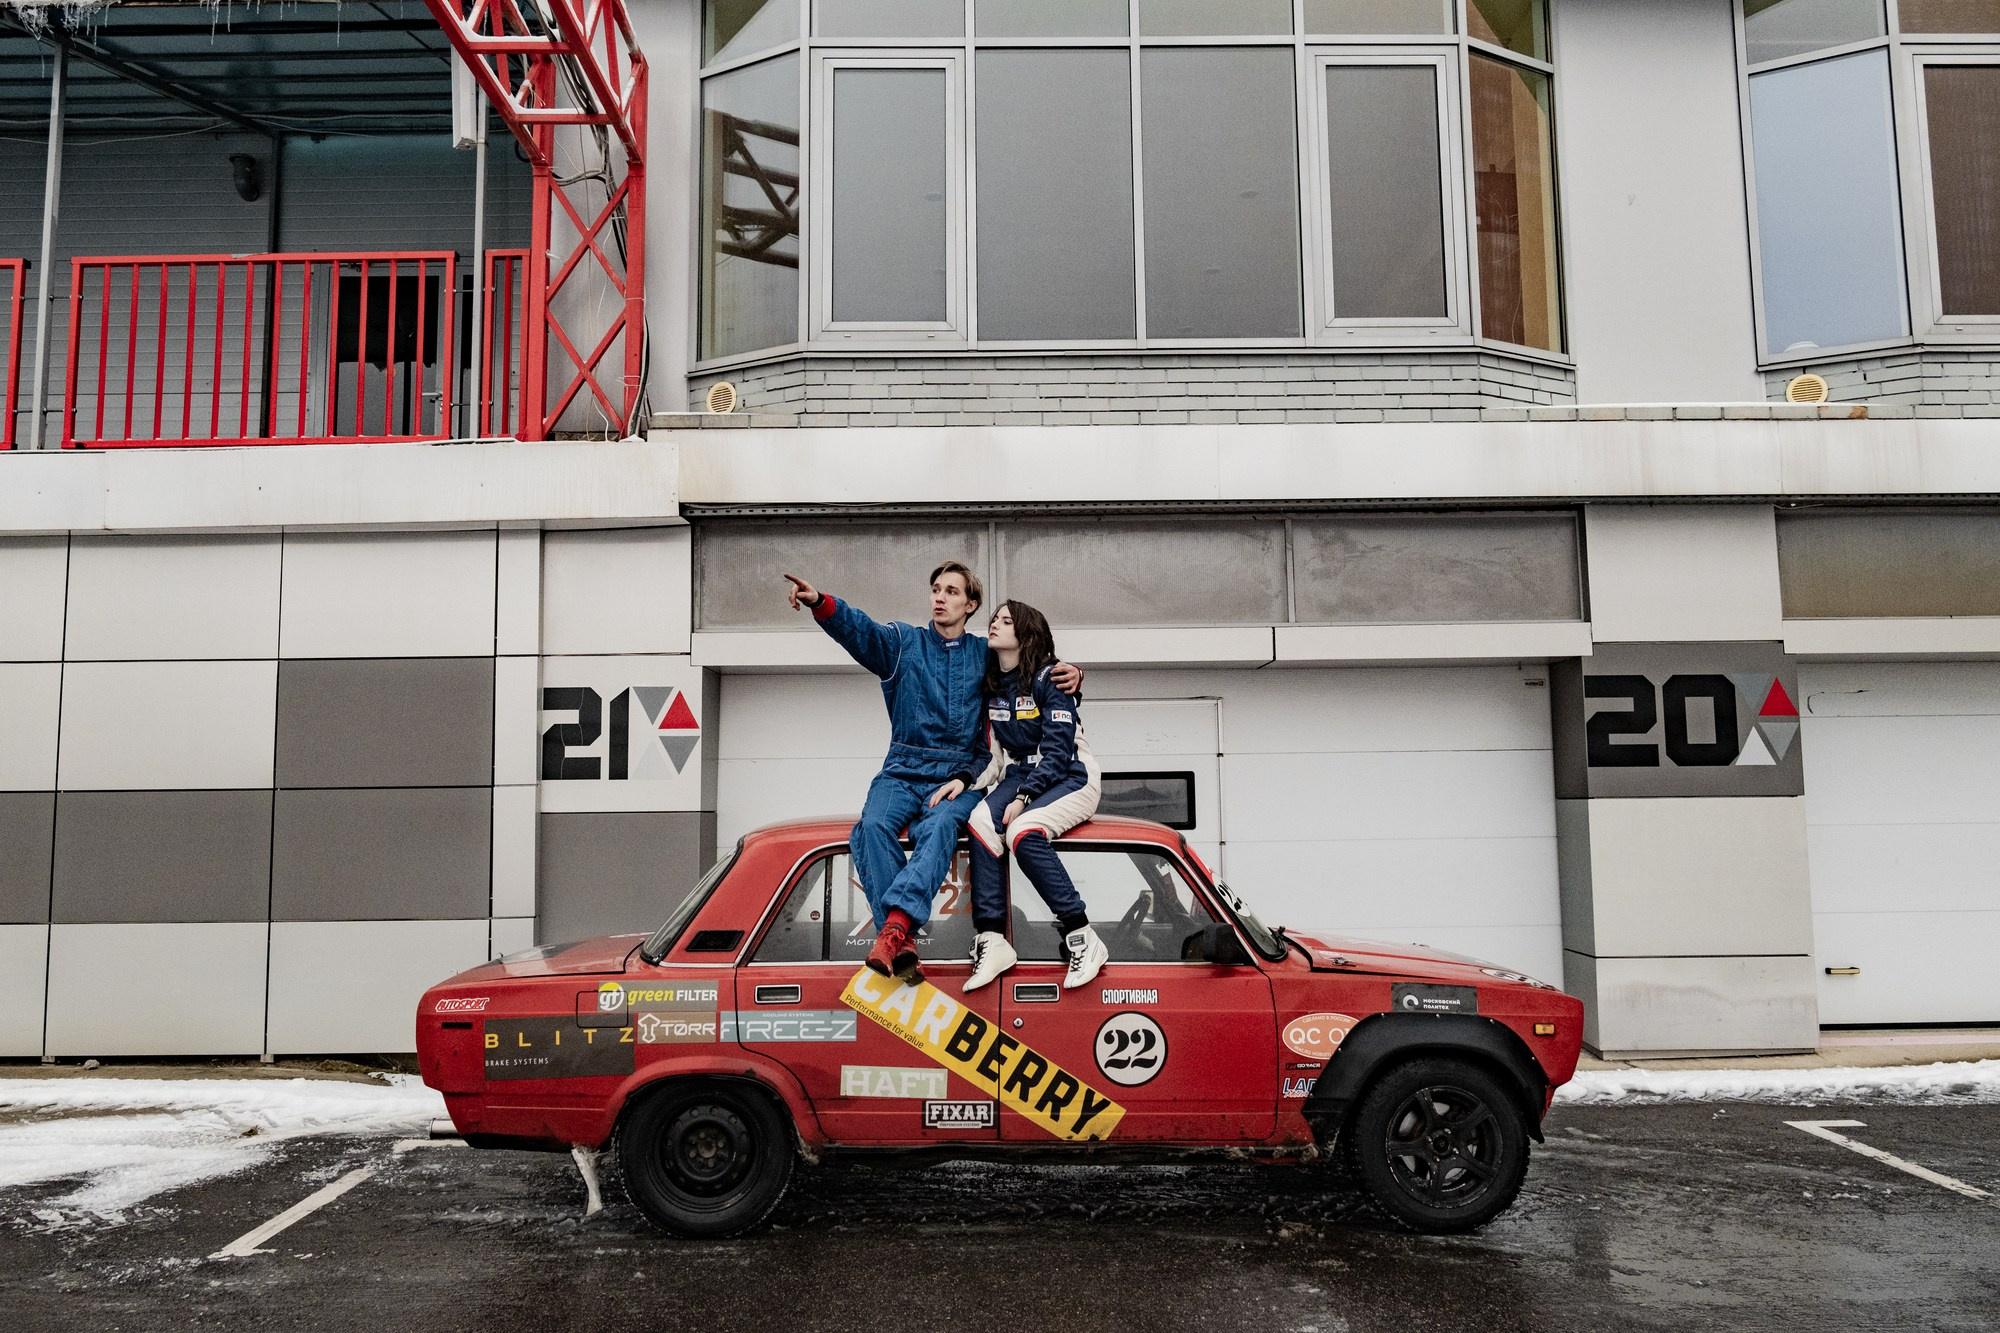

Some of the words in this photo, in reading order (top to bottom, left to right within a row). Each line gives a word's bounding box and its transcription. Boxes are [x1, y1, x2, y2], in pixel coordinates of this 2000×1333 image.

[1584, 674, 1739, 767] 20
[542, 687, 629, 780] 21
[846, 938, 934, 946] MOTRT
[435, 997, 489, 1012] AUTOSPORT
[628, 989, 674, 1005] green
[676, 989, 718, 1001] FILTER
[1102, 989, 1158, 1004] СПОРТИВНАЯ
[845, 994, 893, 1029] Performance
[892, 1023, 904, 1035] for
[904, 1032, 924, 1049] value
[485, 1027, 633, 1048] BLITZ
[1289, 1027, 1320, 1044] QC
[1104, 1029, 1158, 1069] 22
[845, 1070, 944, 1099] HAFT
[931, 1105, 989, 1120] FIXAR
